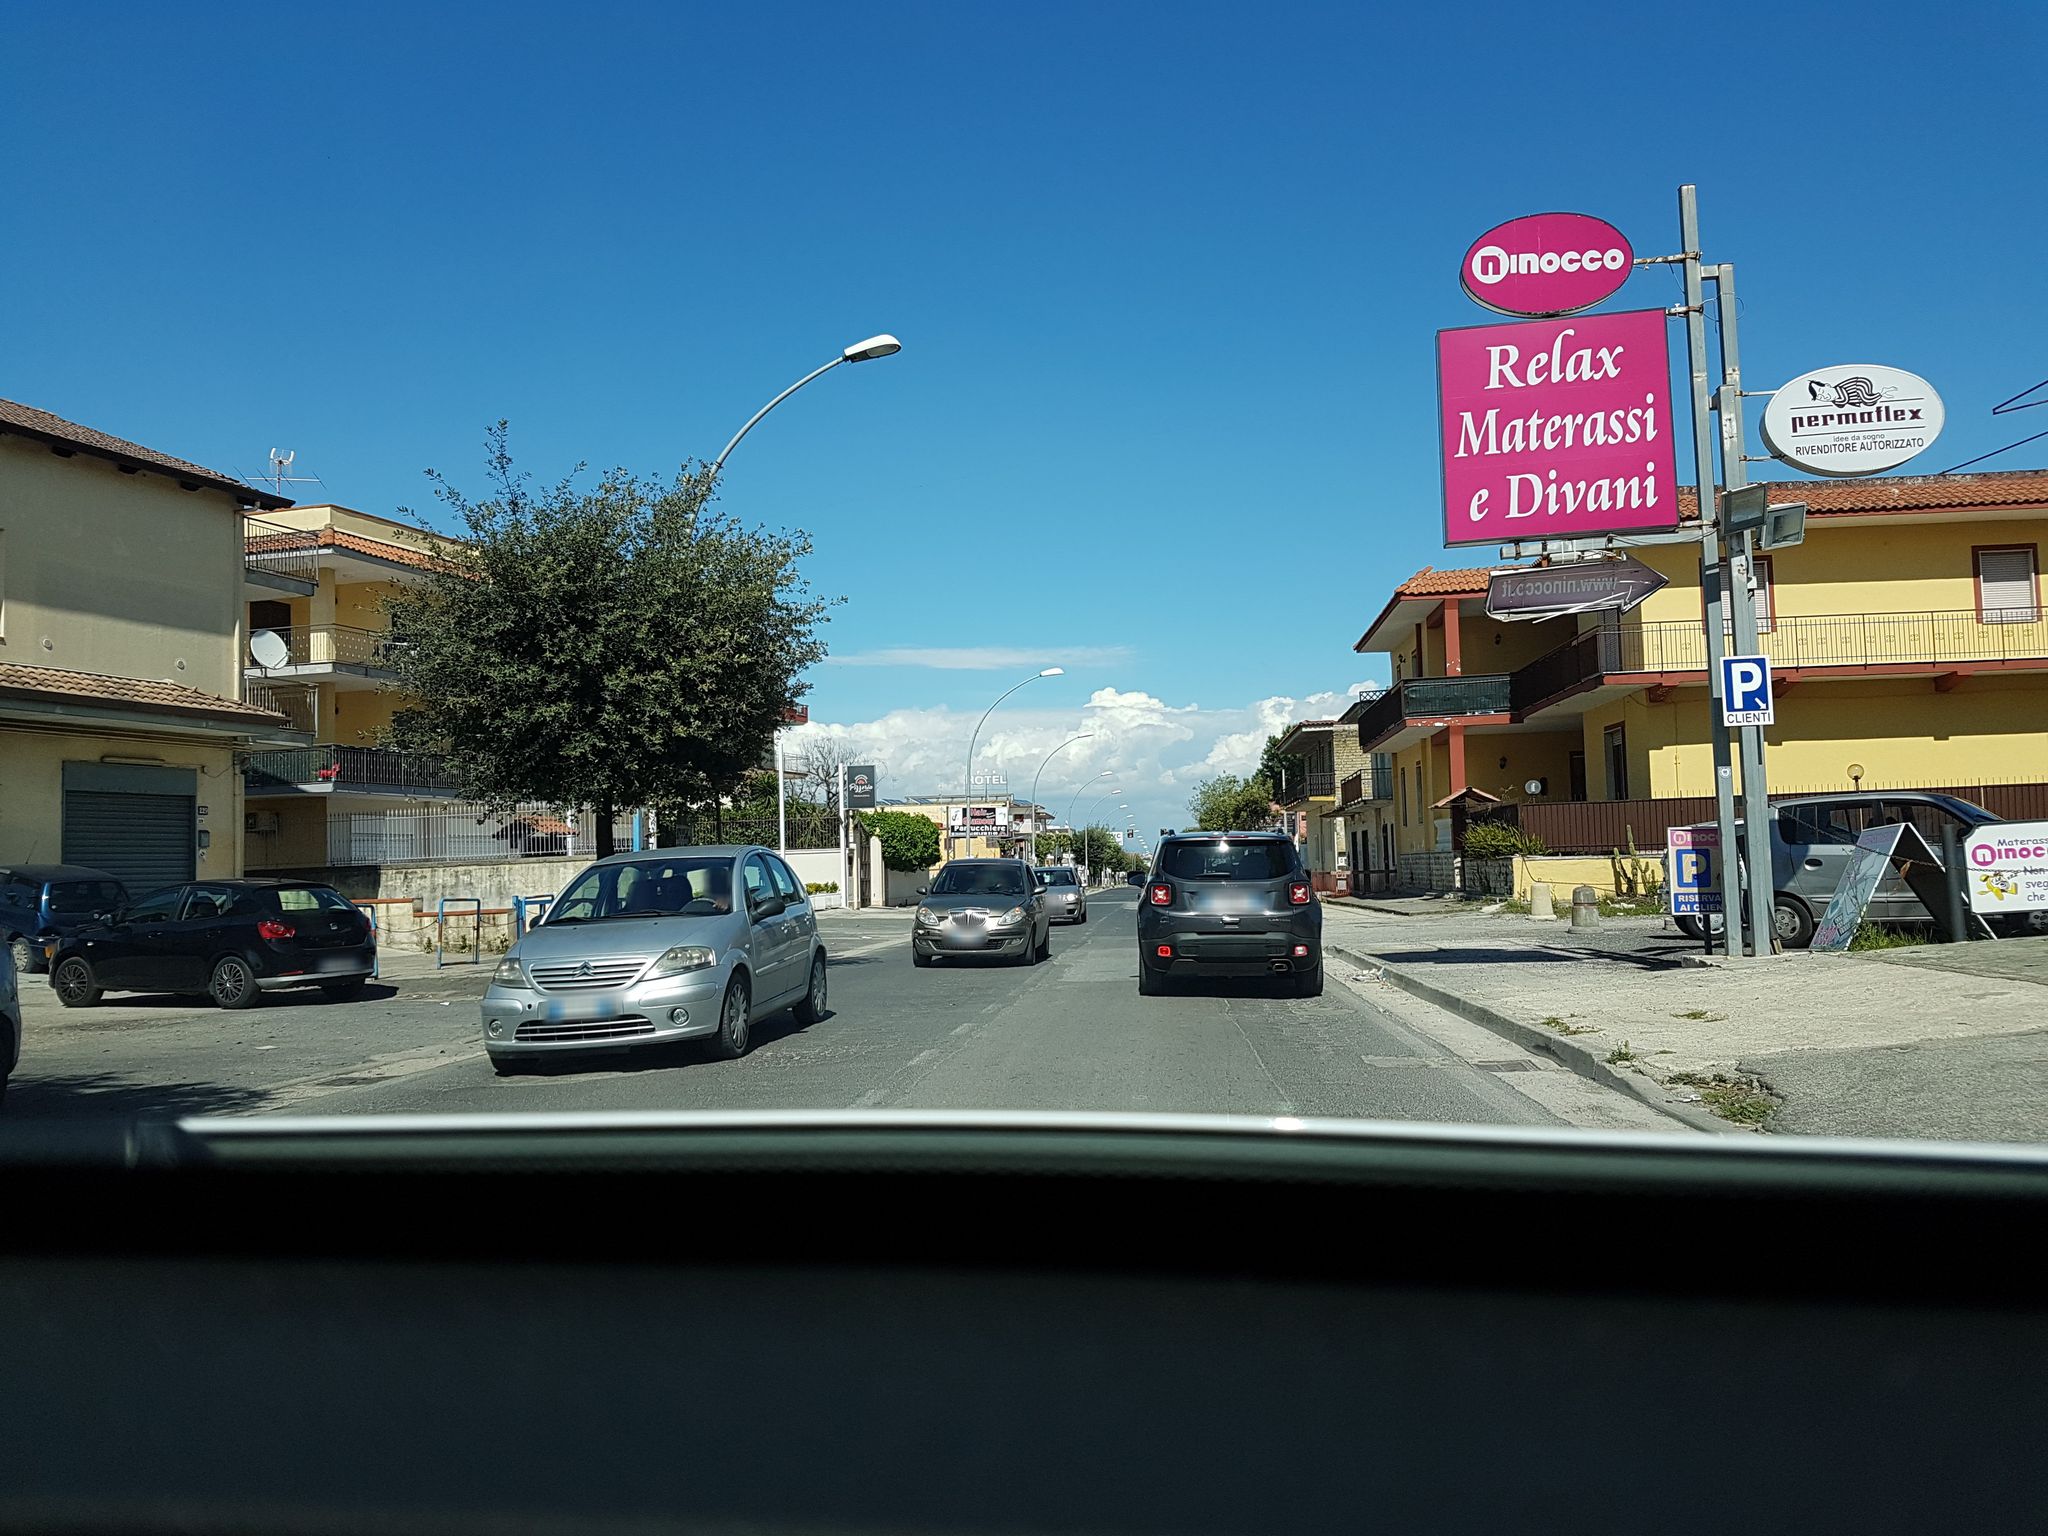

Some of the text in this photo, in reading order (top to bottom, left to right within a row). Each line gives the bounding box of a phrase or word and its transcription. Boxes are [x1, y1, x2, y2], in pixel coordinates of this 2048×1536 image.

[1484, 328, 1624, 390] Relax
[1453, 392, 1658, 458] Materassi
[1791, 405, 1924, 434] permaflex
[1795, 437, 1924, 456] RIVENDITORE AUTORIZZATO
[1833, 432, 1885, 443] idee da sogno
[1469, 461, 1659, 522] e Divani
[1731, 662, 1763, 710] P
[1726, 711, 1771, 724] CLIENTI
[1682, 853, 1707, 884] P
[1680, 903, 1691, 912] AI
[2027, 891, 2046, 902] che
